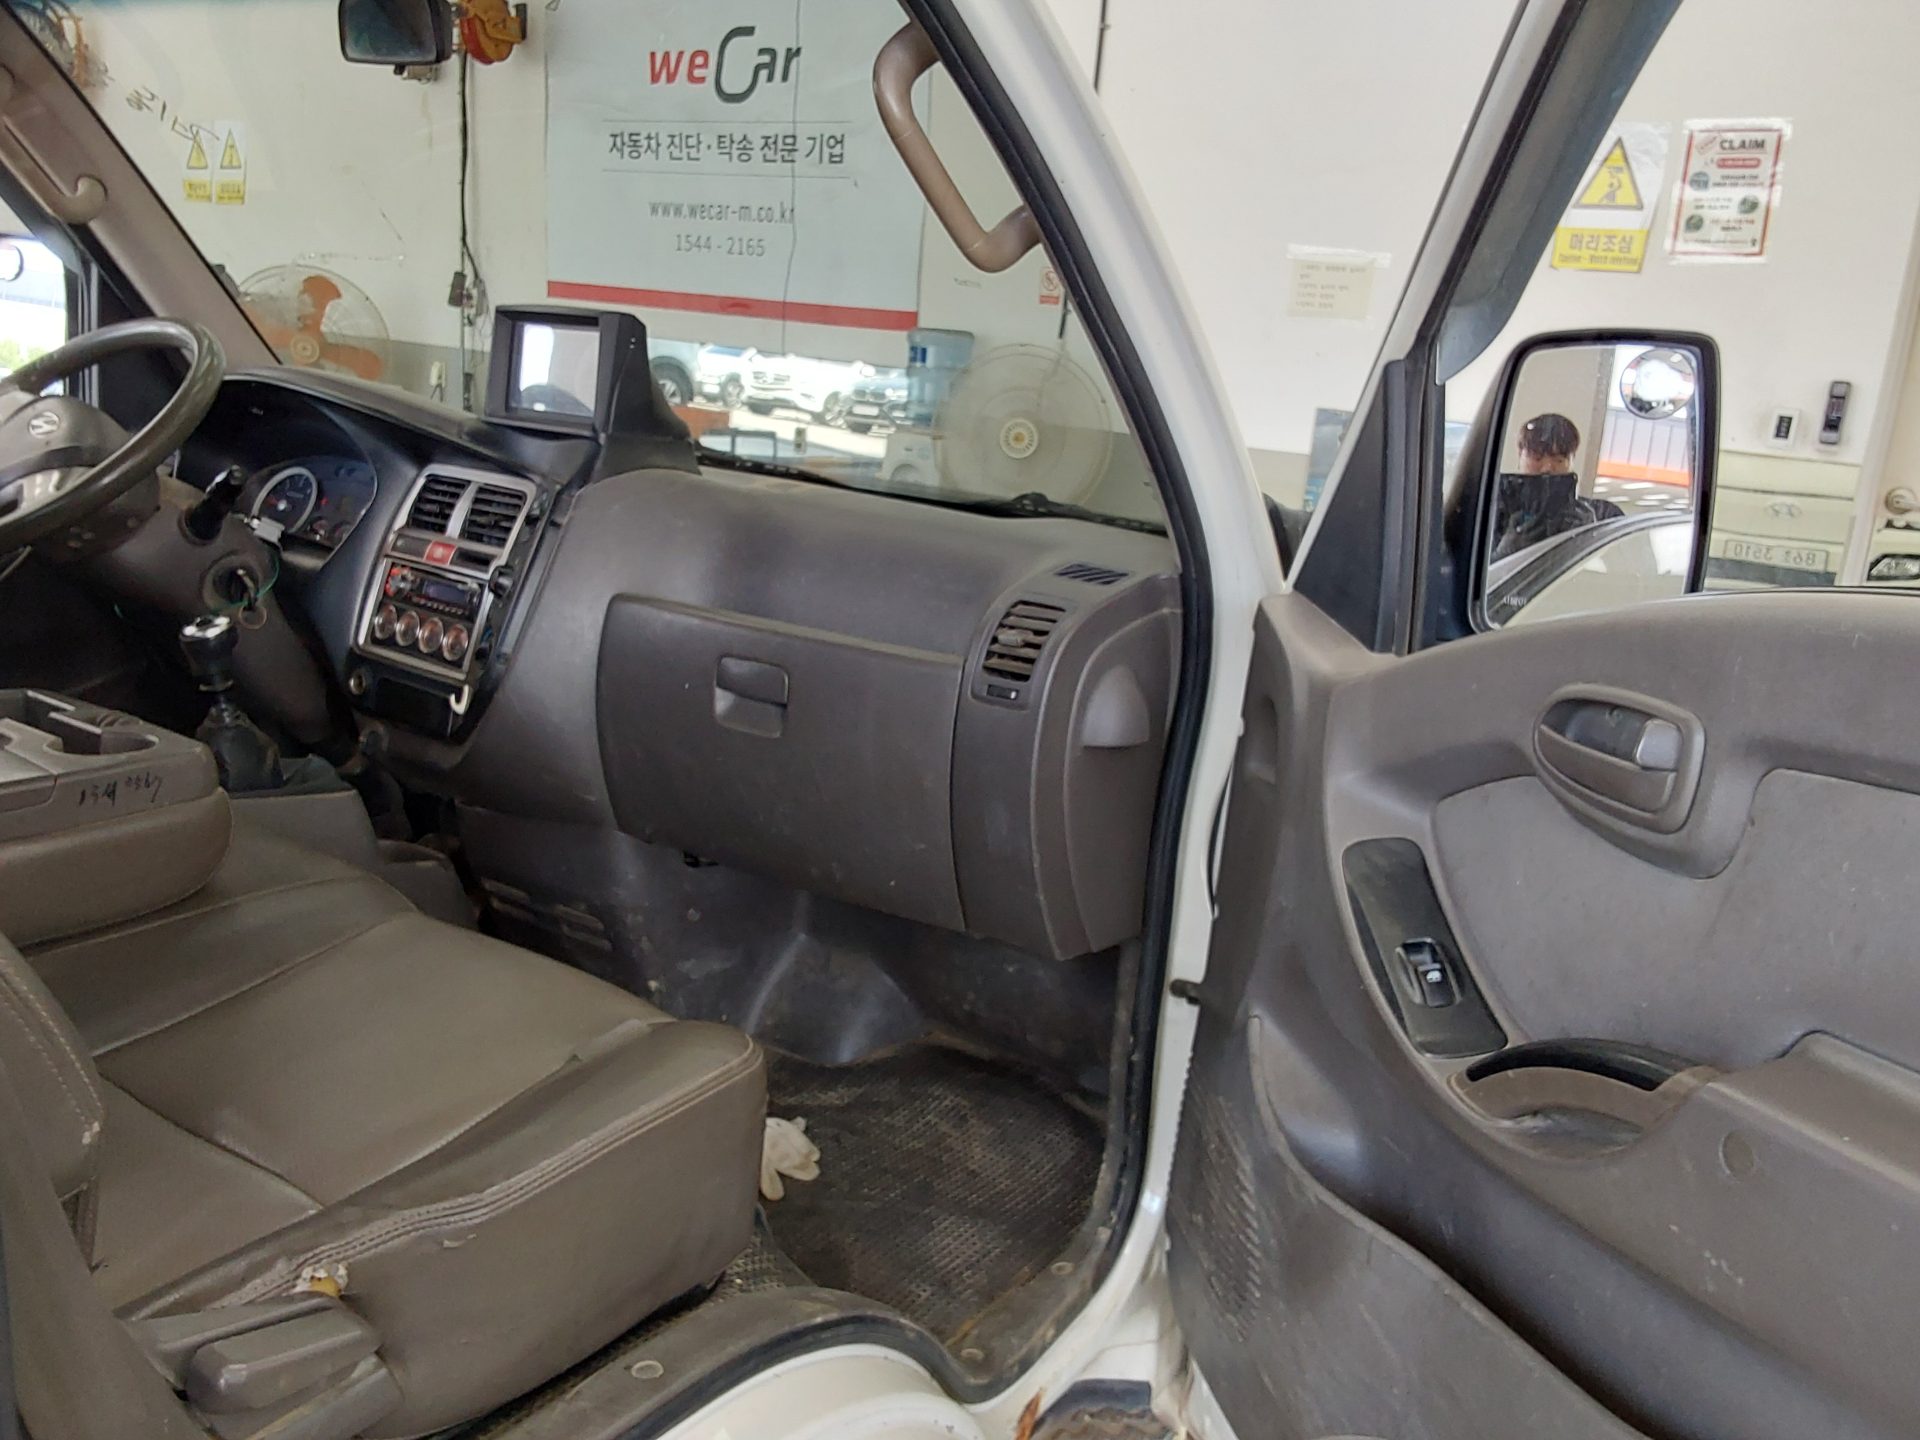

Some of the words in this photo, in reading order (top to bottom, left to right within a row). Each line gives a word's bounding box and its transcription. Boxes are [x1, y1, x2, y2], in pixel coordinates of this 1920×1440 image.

[649, 26, 801, 104] weCar
[609, 131, 662, 161] 자동차
[760, 134, 798, 164] 전문
[805, 134, 845, 165] 기업
[1719, 139, 1766, 151] CLAIM
[649, 201, 795, 224] www.wecar-m.co.kr
